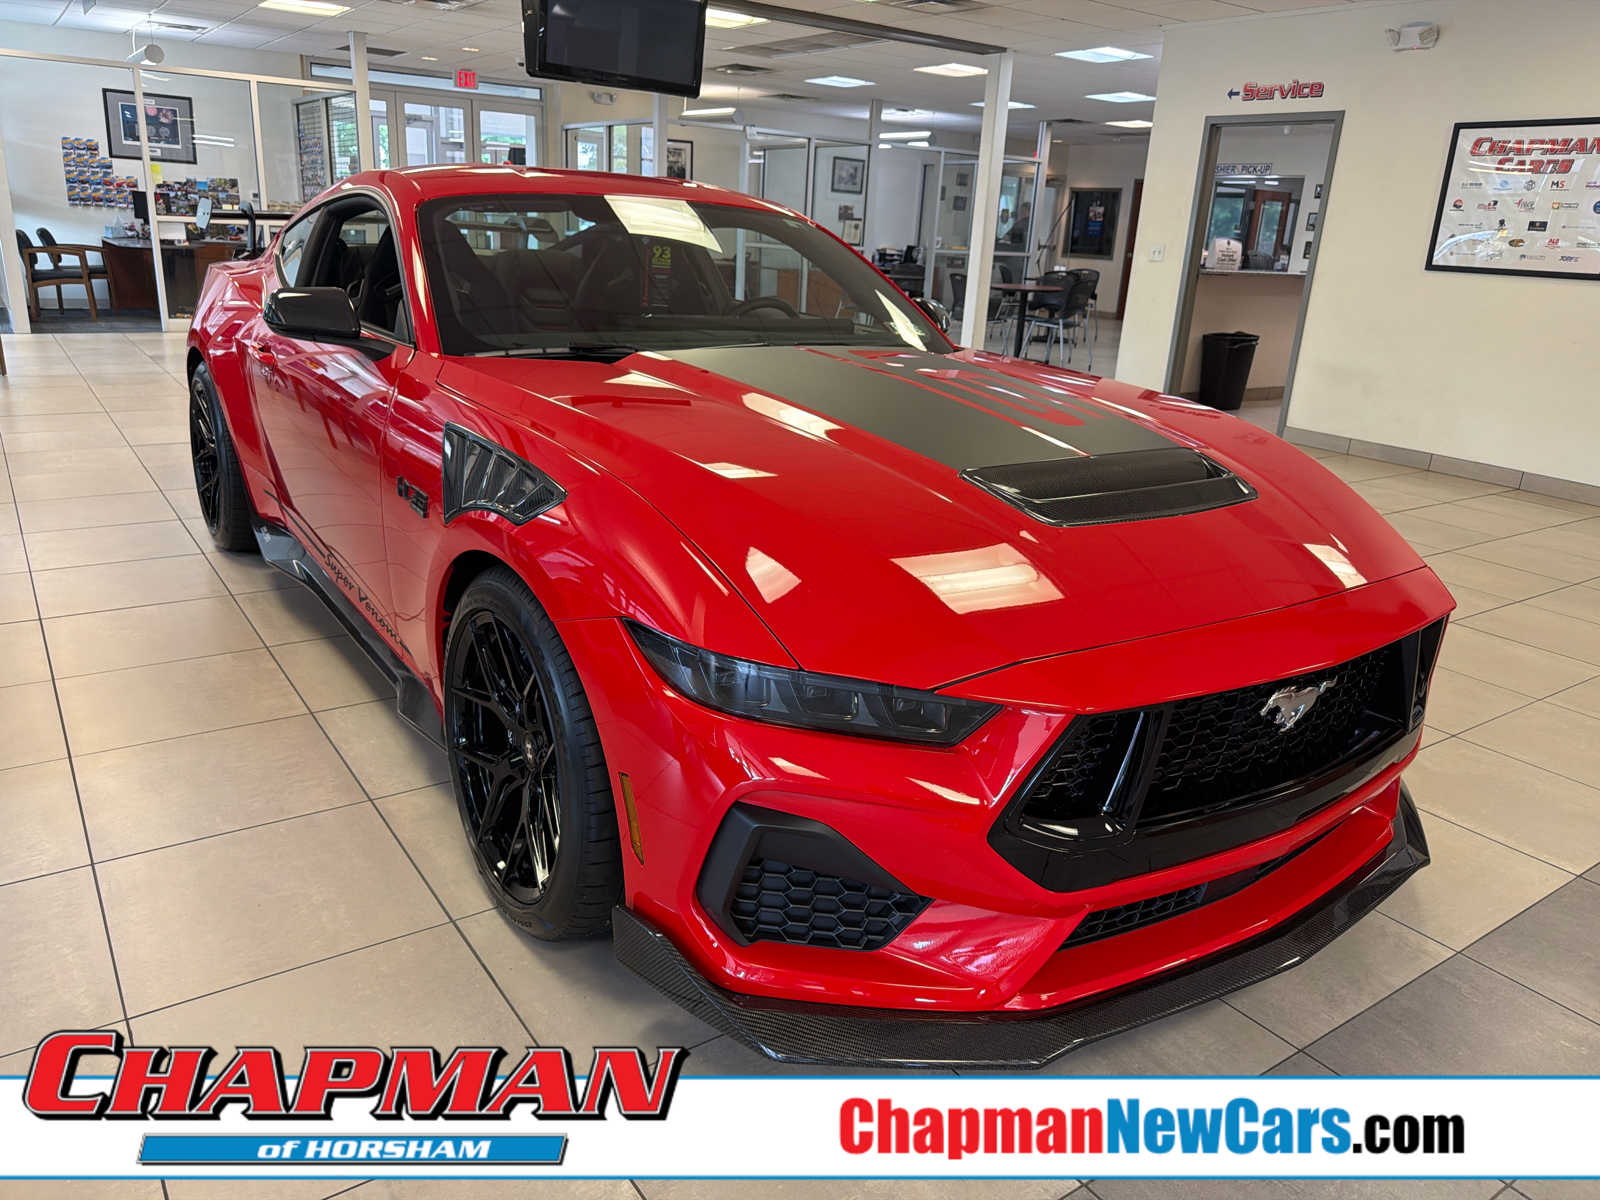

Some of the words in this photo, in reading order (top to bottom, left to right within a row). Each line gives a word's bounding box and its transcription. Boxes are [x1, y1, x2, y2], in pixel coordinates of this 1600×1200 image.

[458, 71, 476, 88] EXIT
[1242, 79, 1324, 101] Service
[653, 246, 671, 257] 93
[324, 551, 355, 592] Super
